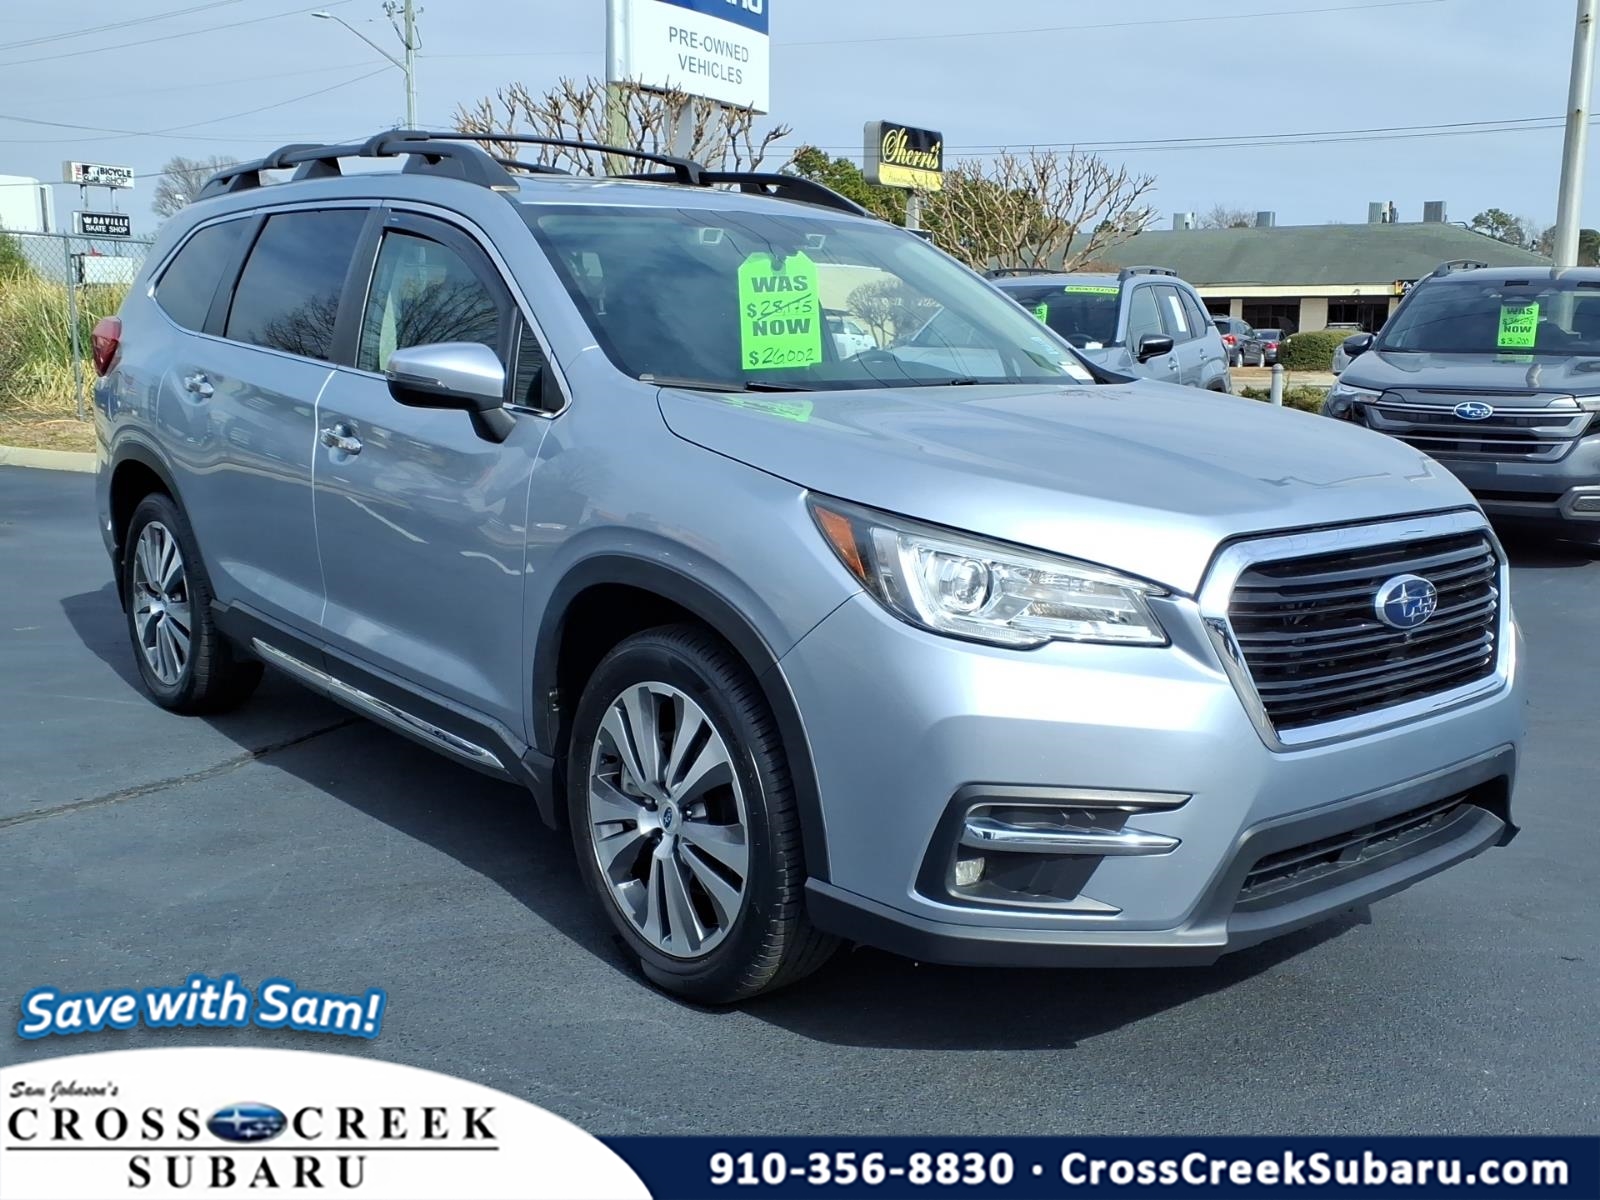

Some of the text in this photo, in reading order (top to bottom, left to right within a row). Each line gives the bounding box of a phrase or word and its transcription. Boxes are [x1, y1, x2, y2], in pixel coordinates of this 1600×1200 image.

[668, 26, 749, 63] PRE-OWNED
[678, 53, 743, 85] VEHICLES
[100, 167, 131, 178] BICYCLE
[105, 176, 128, 185] SHOP
[751, 275, 808, 293] WAS
[1506, 307, 1534, 315] WAS
[752, 318, 811, 337] NOW
[1503, 325, 1532, 333] NOW
